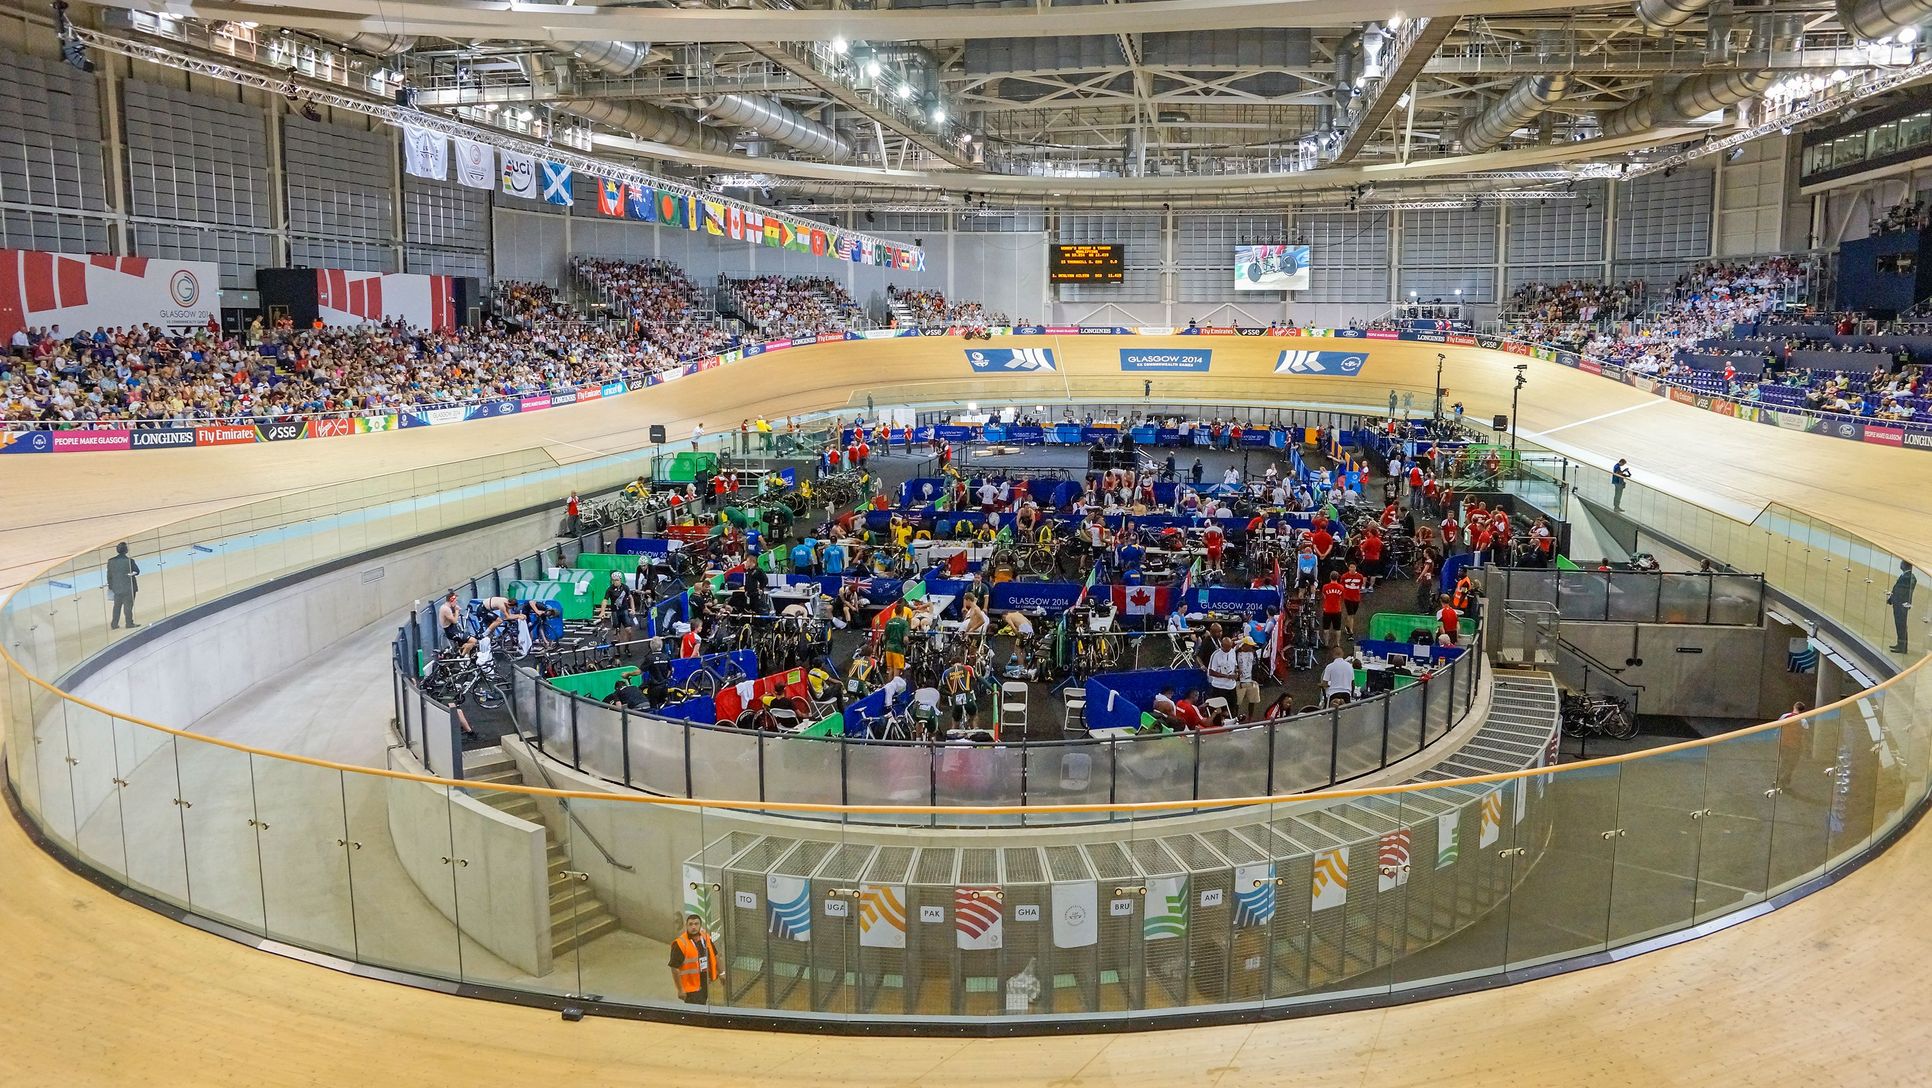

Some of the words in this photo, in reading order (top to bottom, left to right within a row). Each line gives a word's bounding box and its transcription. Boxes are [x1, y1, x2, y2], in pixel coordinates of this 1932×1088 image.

[160, 310, 197, 318] GLASGOW
[1127, 355, 1180, 363] GLASGOW
[198, 429, 216, 443] Fly
[216, 427, 254, 441] Emirates
[277, 424, 297, 439] sse
[54, 437, 79, 446] PEOPLE
[80, 436, 98, 445] MAKE
[98, 436, 129, 445] GLASGOW
[133, 431, 194, 446] LONGINES
[627, 549, 659, 557] GLASGOW
[1008, 596, 1050, 605] GLASGOW
[1052, 598, 1069, 606] 2014
[1200, 601, 1244, 610] GLASGOW
[1246, 602, 1263, 611] 2014
[739, 895, 752, 904] TTO
[1204, 893, 1220, 901] ANT
[827, 903, 845, 911] UGA
[1114, 902, 1130, 911] BRU
[923, 910, 941, 918] PAK
[1017, 908, 1037, 917] GHA
